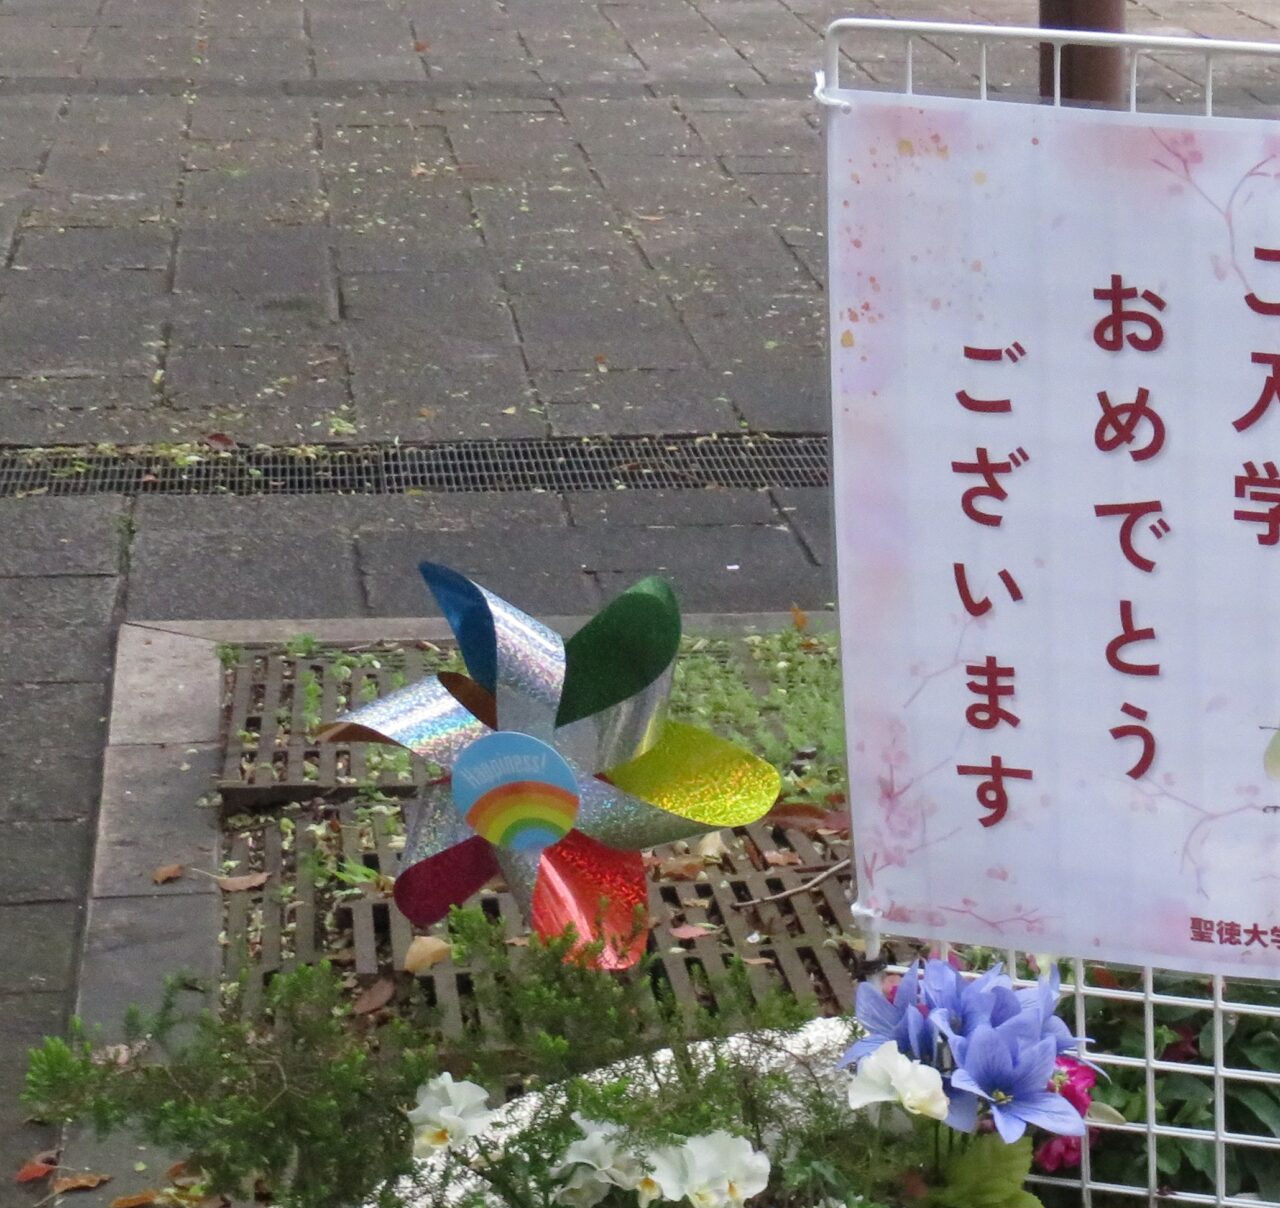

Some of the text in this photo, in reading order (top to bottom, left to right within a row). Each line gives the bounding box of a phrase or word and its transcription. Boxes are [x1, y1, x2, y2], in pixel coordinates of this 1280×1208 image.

[952, 341, 1033, 829] ございます
[1092, 273, 1171, 782] おめでとう
